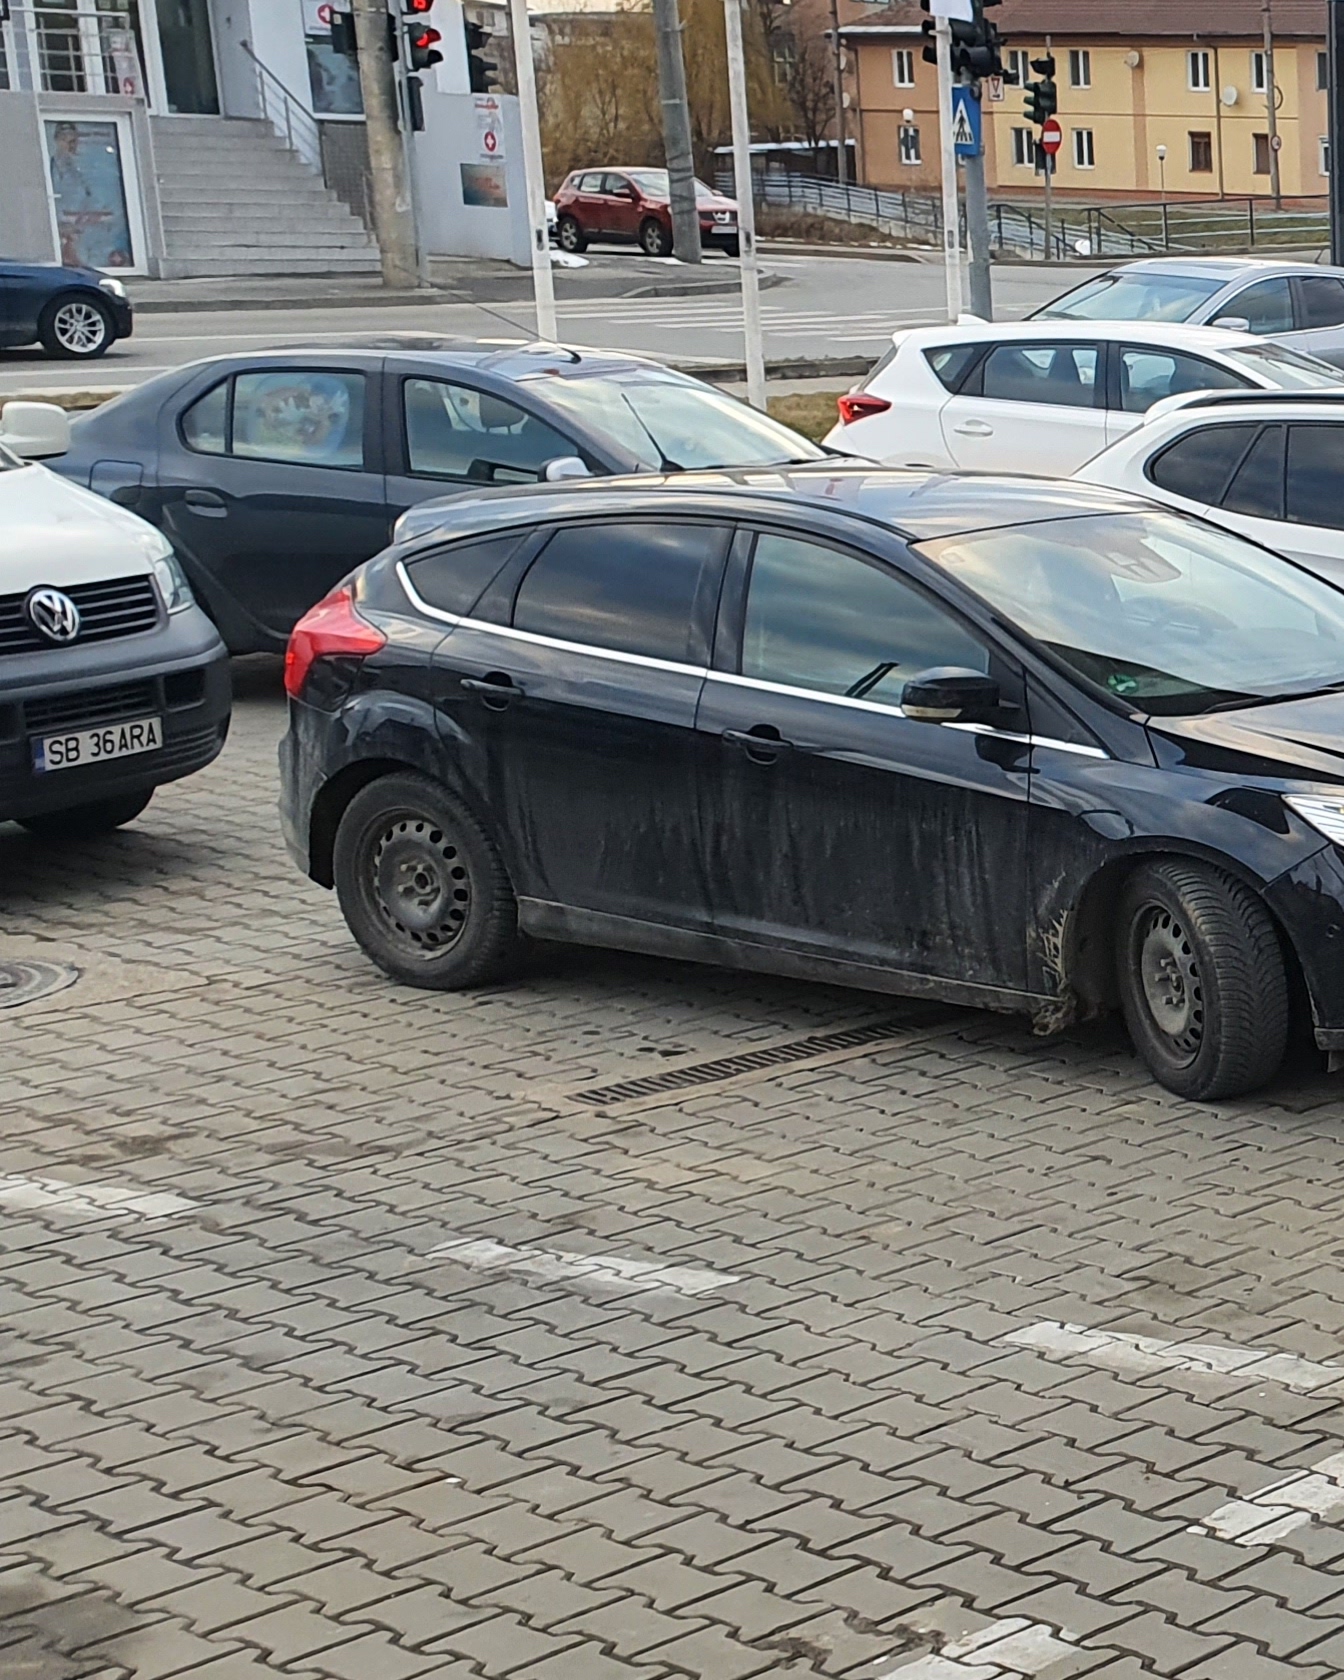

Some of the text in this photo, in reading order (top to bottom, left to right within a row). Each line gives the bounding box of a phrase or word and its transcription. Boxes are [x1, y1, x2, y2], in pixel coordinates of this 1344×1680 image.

[48, 722, 157, 765] SB 36 ARA
